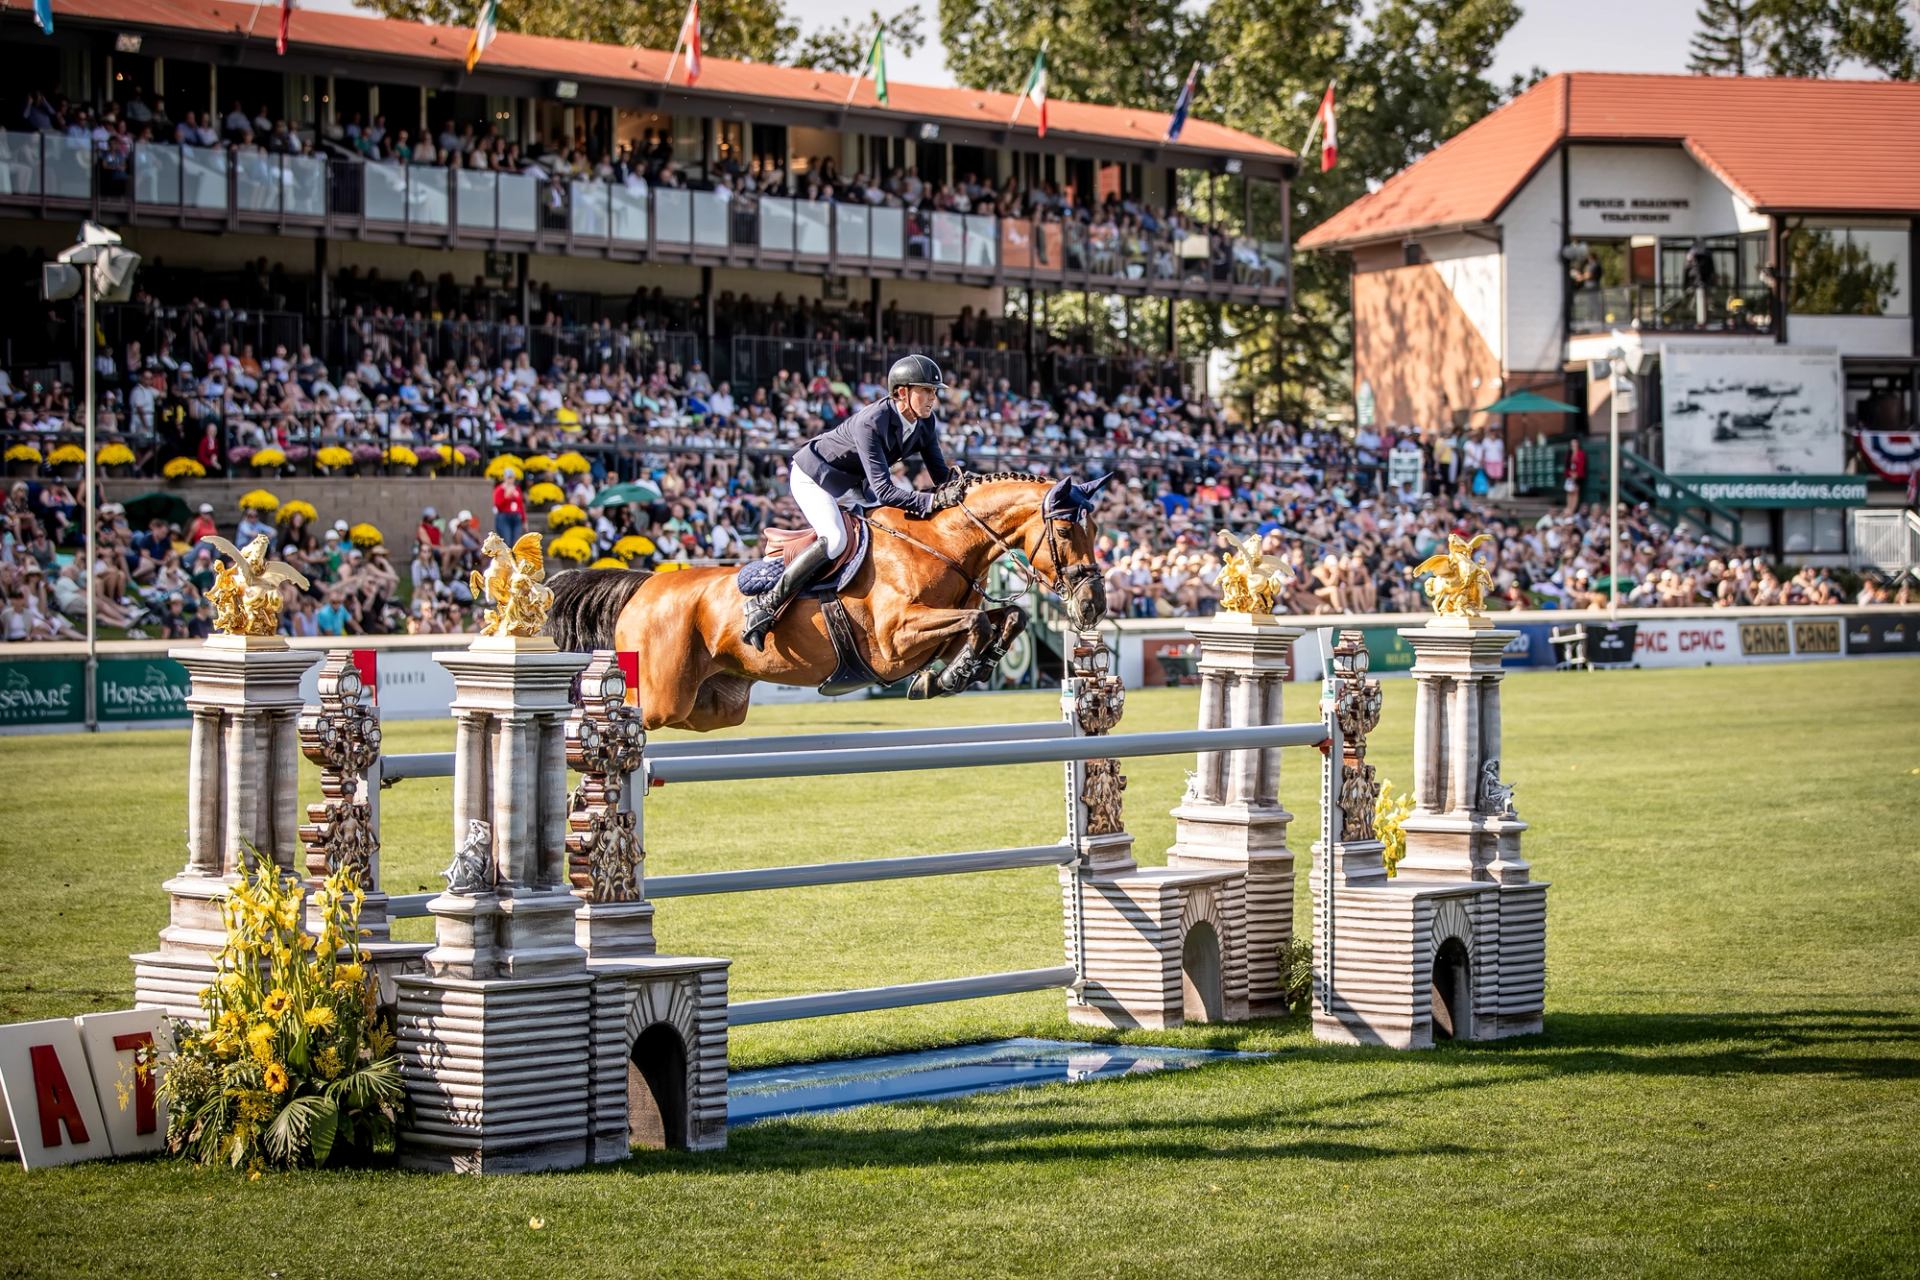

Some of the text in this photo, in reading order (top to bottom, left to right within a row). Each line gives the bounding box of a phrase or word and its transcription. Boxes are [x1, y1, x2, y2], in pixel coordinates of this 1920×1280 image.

[1656, 480, 1865, 500] wsprucemeadows.com
[1634, 630, 1726, 652] PKC CPKC
[0, 684, 71, 709] SEWARE
[102, 681, 192, 704] HORSEWA
[0, 709, 48, 719] ELAND
[30, 1044, 90, 1148] A
